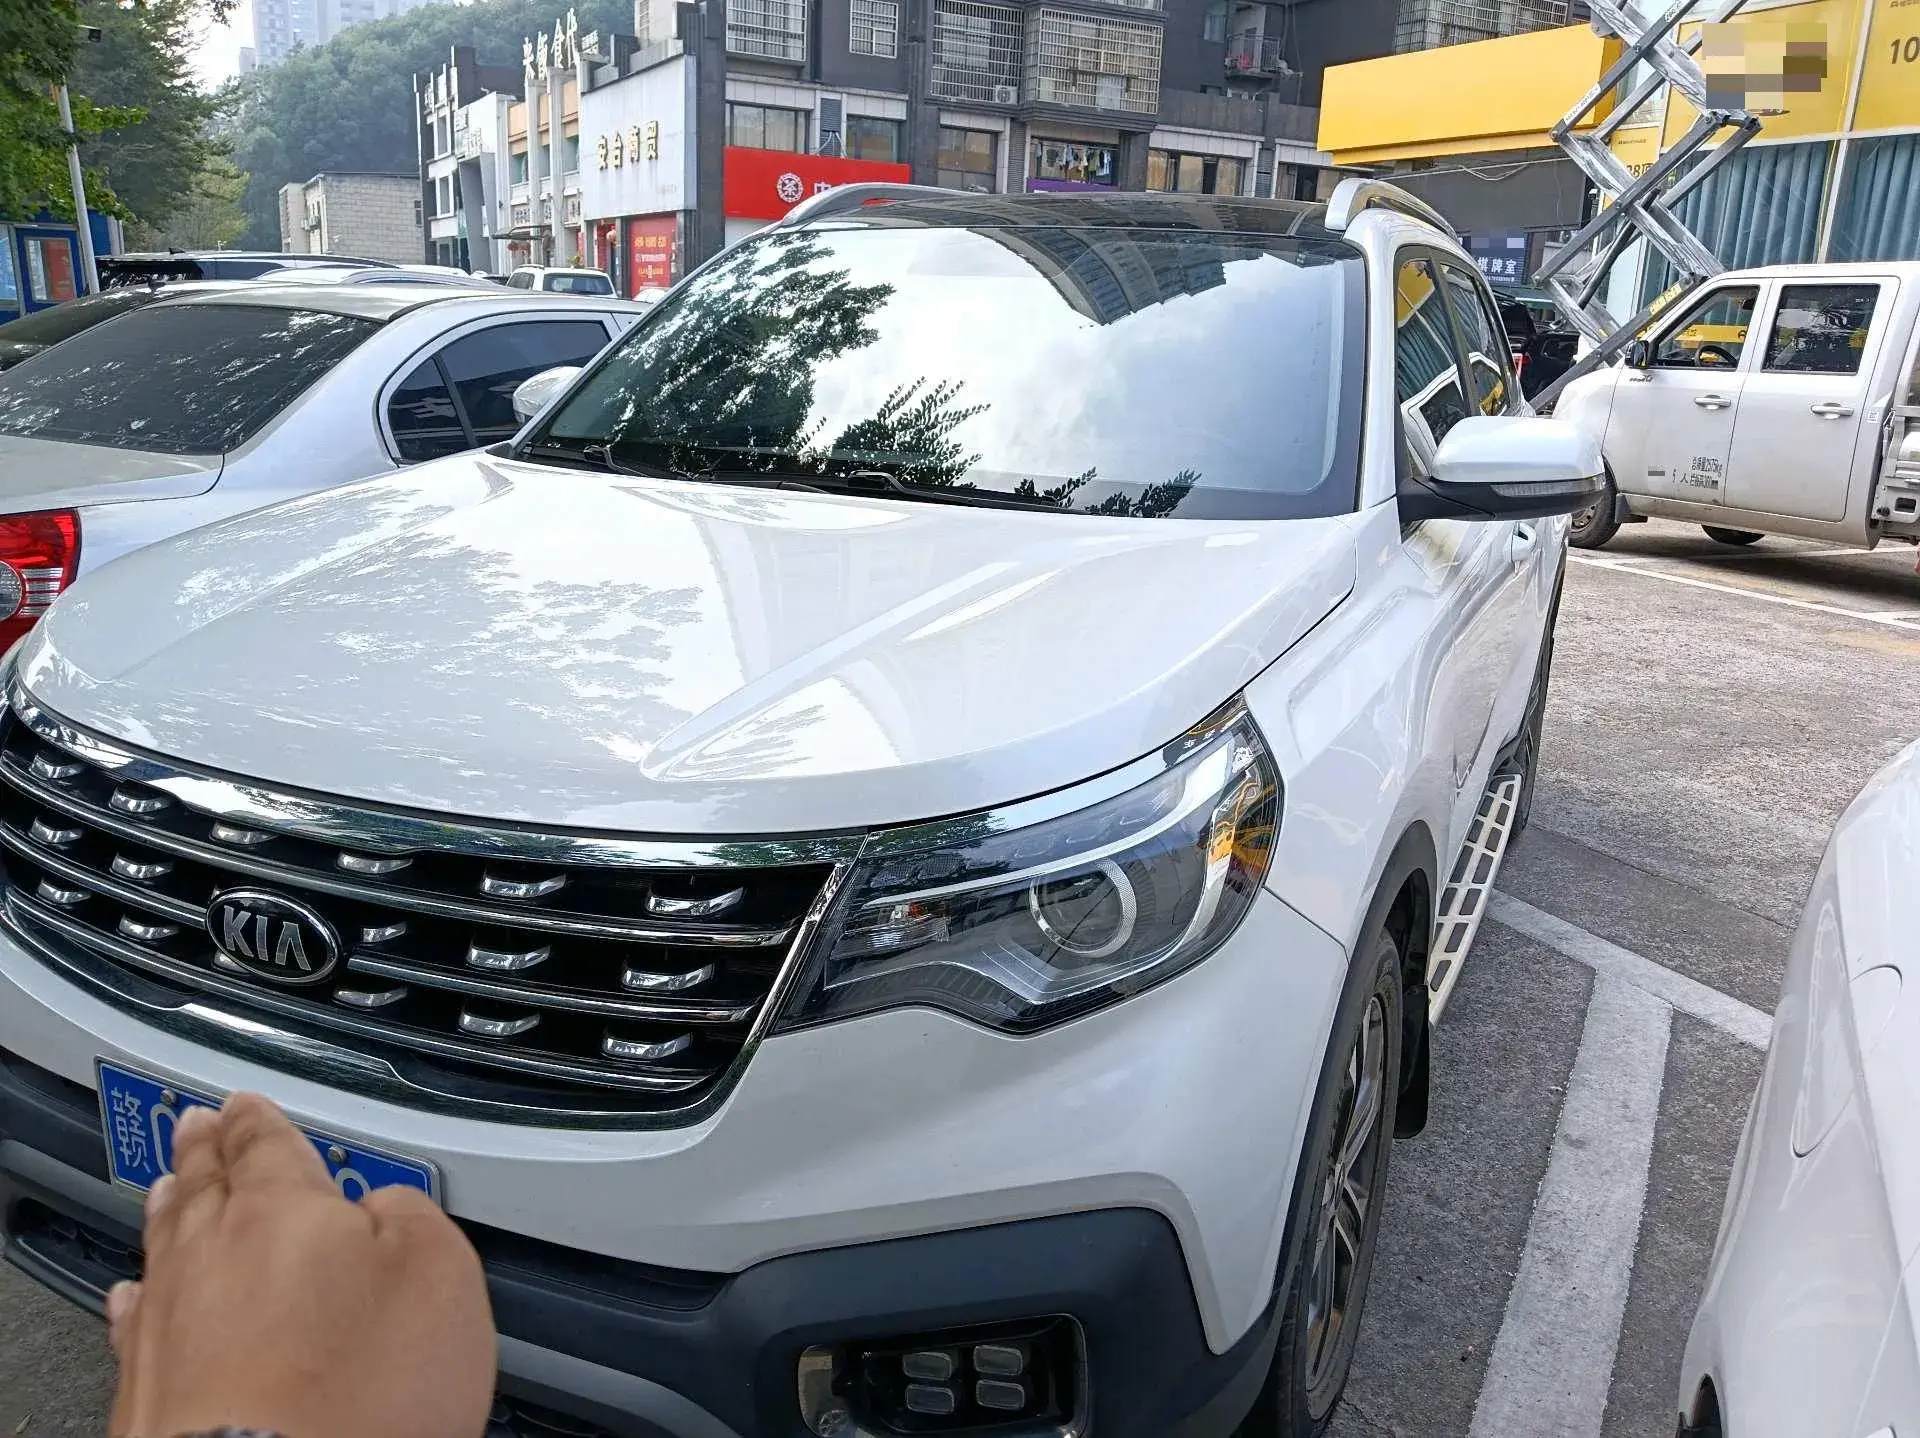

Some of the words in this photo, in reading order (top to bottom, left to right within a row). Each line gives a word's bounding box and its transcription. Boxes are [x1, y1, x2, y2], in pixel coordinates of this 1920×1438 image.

[1478, 256, 1517, 275] 棋牌室
[223, 904, 312, 972] KIA
